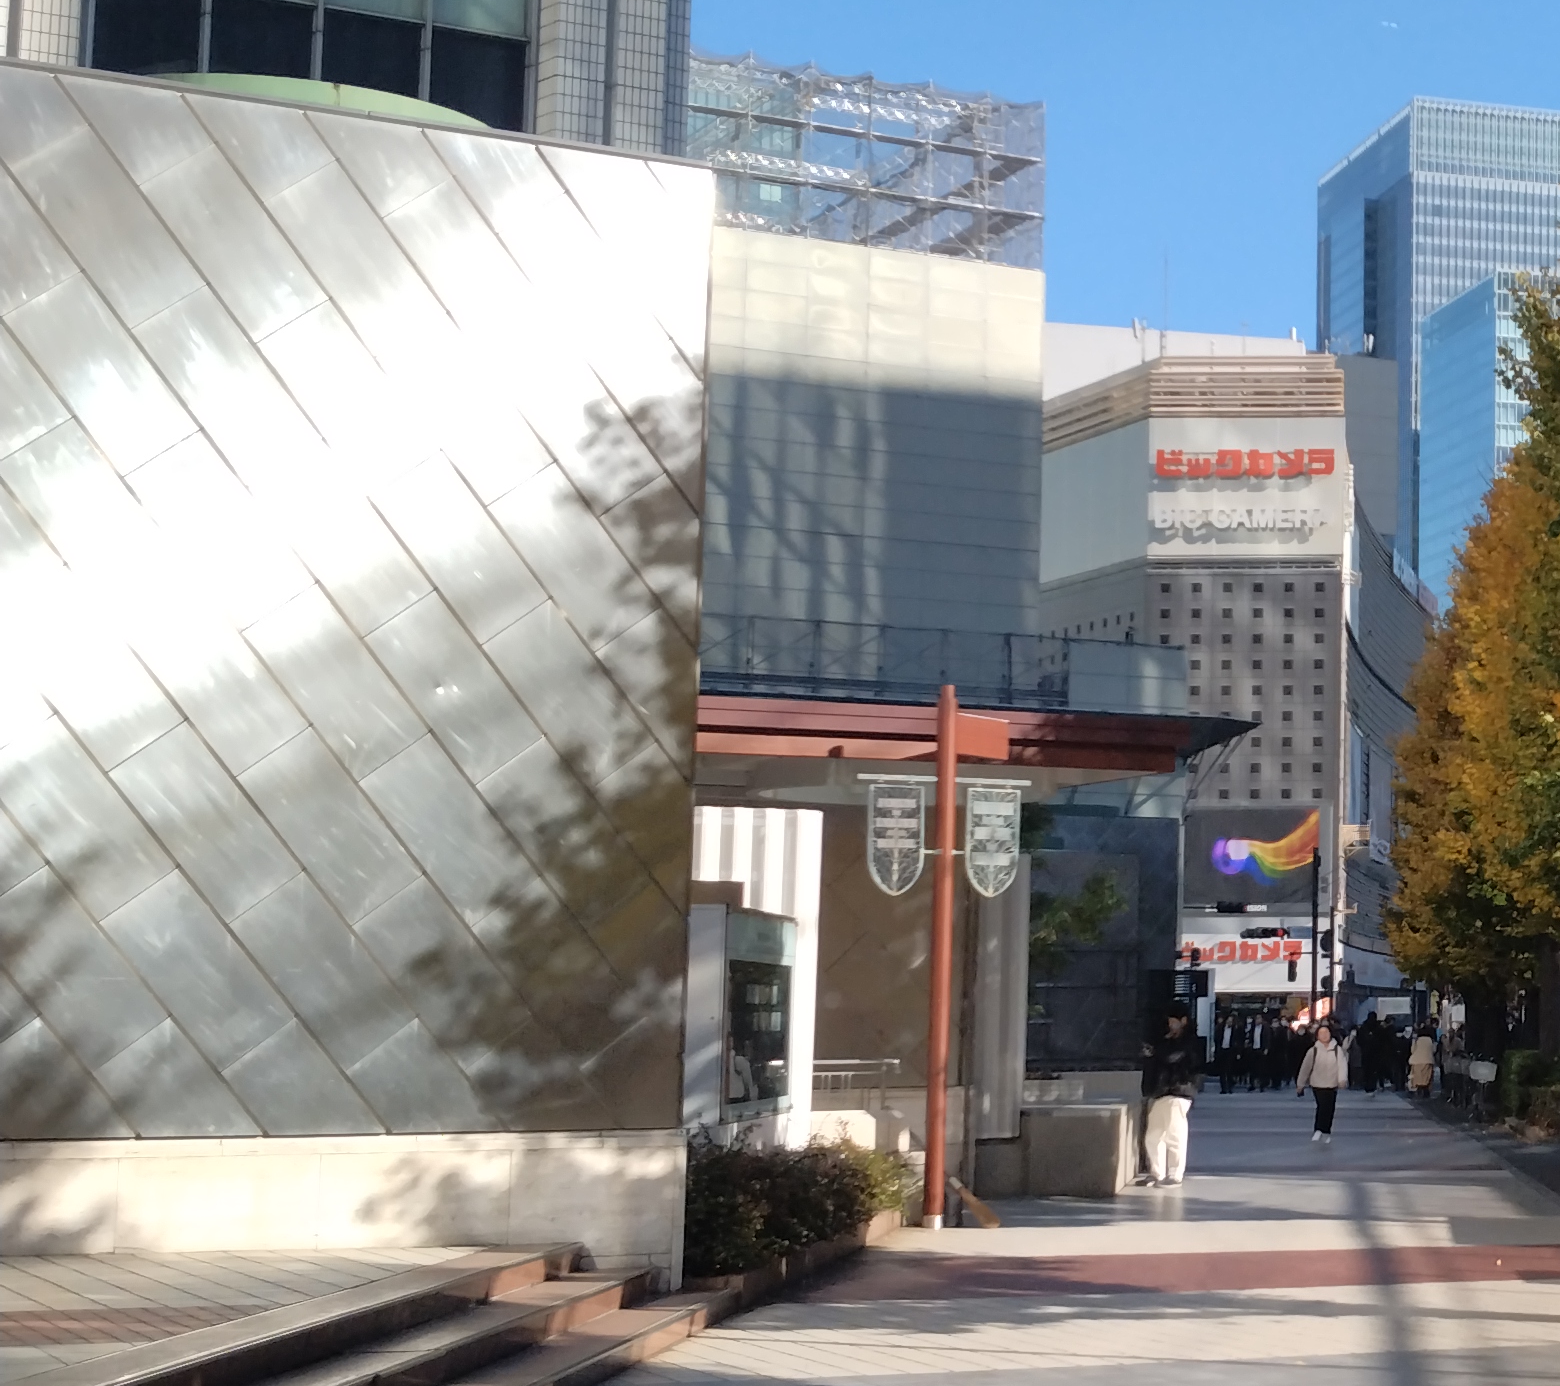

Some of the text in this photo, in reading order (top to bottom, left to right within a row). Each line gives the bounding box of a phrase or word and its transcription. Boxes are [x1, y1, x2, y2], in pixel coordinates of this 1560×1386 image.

[1155, 449, 1335, 477] ビックカメラ
[1211, 508, 1331, 529] CAMERA
